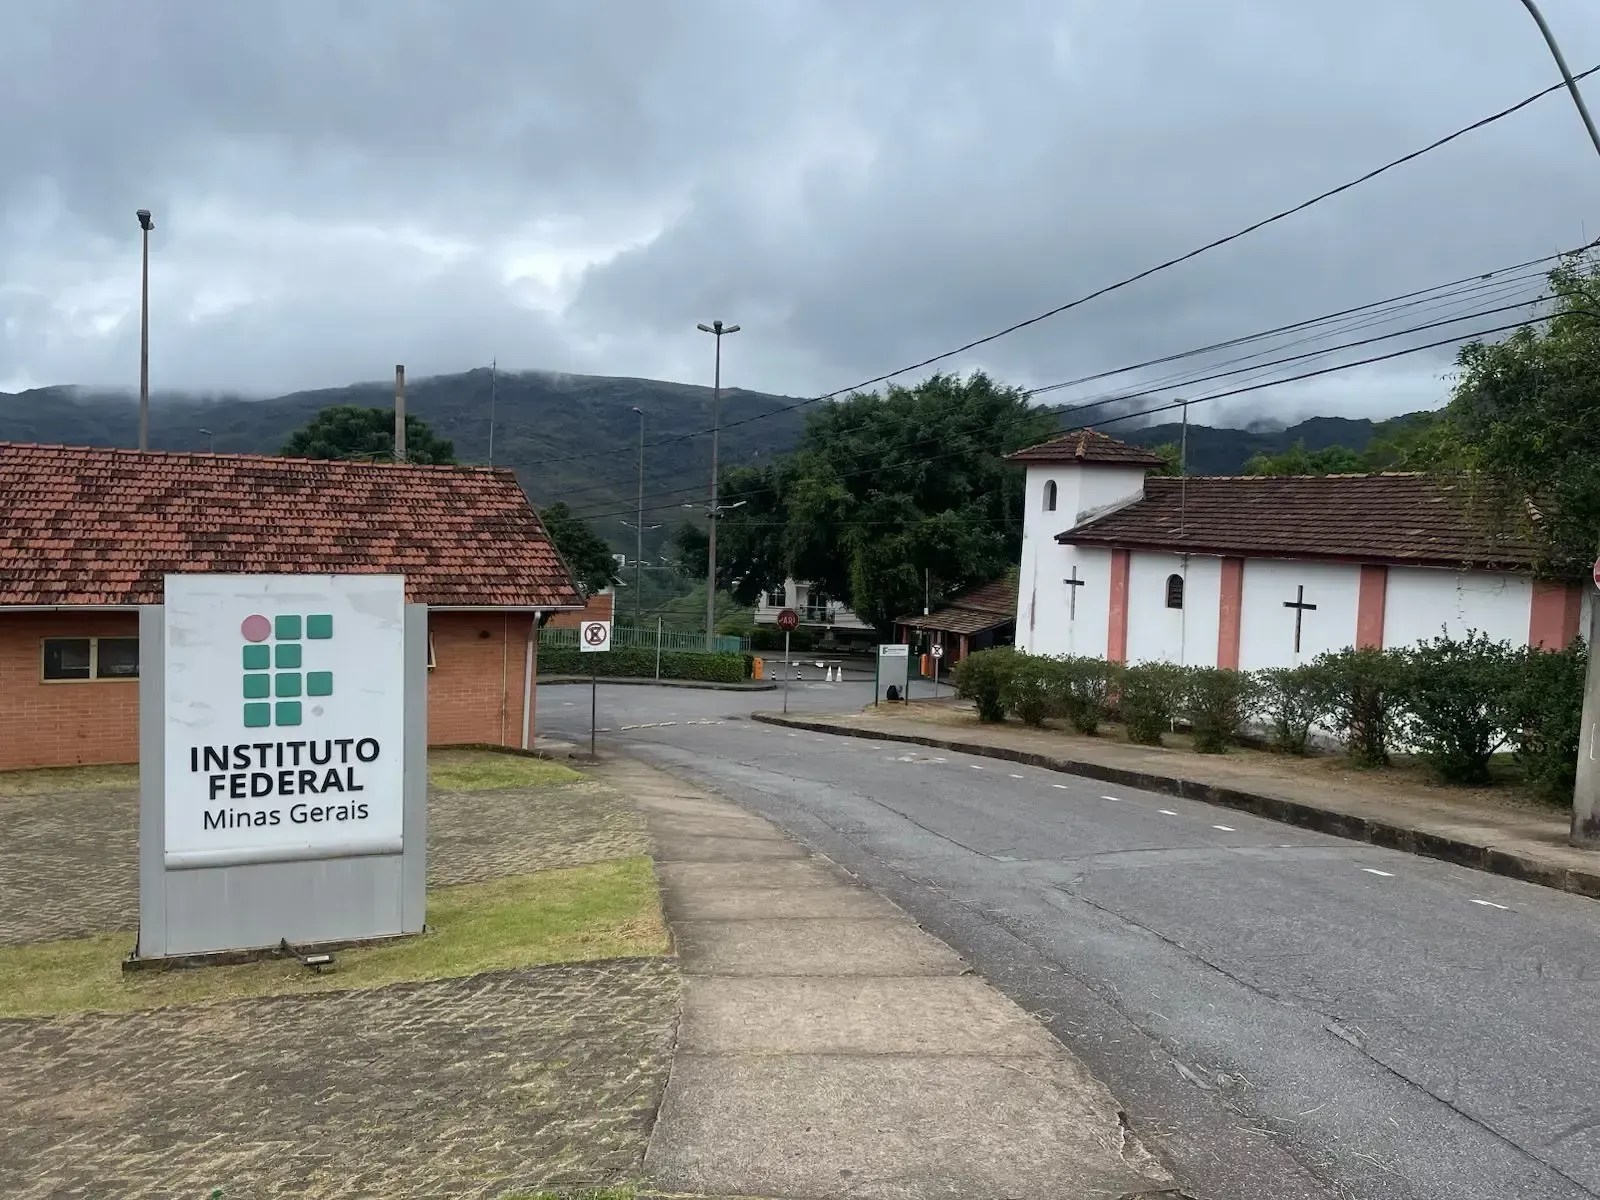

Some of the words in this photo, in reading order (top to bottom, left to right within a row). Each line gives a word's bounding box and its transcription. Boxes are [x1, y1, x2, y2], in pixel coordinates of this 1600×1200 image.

[190, 737, 381, 772] INSTITUTO
[208, 766, 365, 801] FEDERAL
[203, 808, 281, 830] Minas
[289, 799, 369, 824] Gerais
